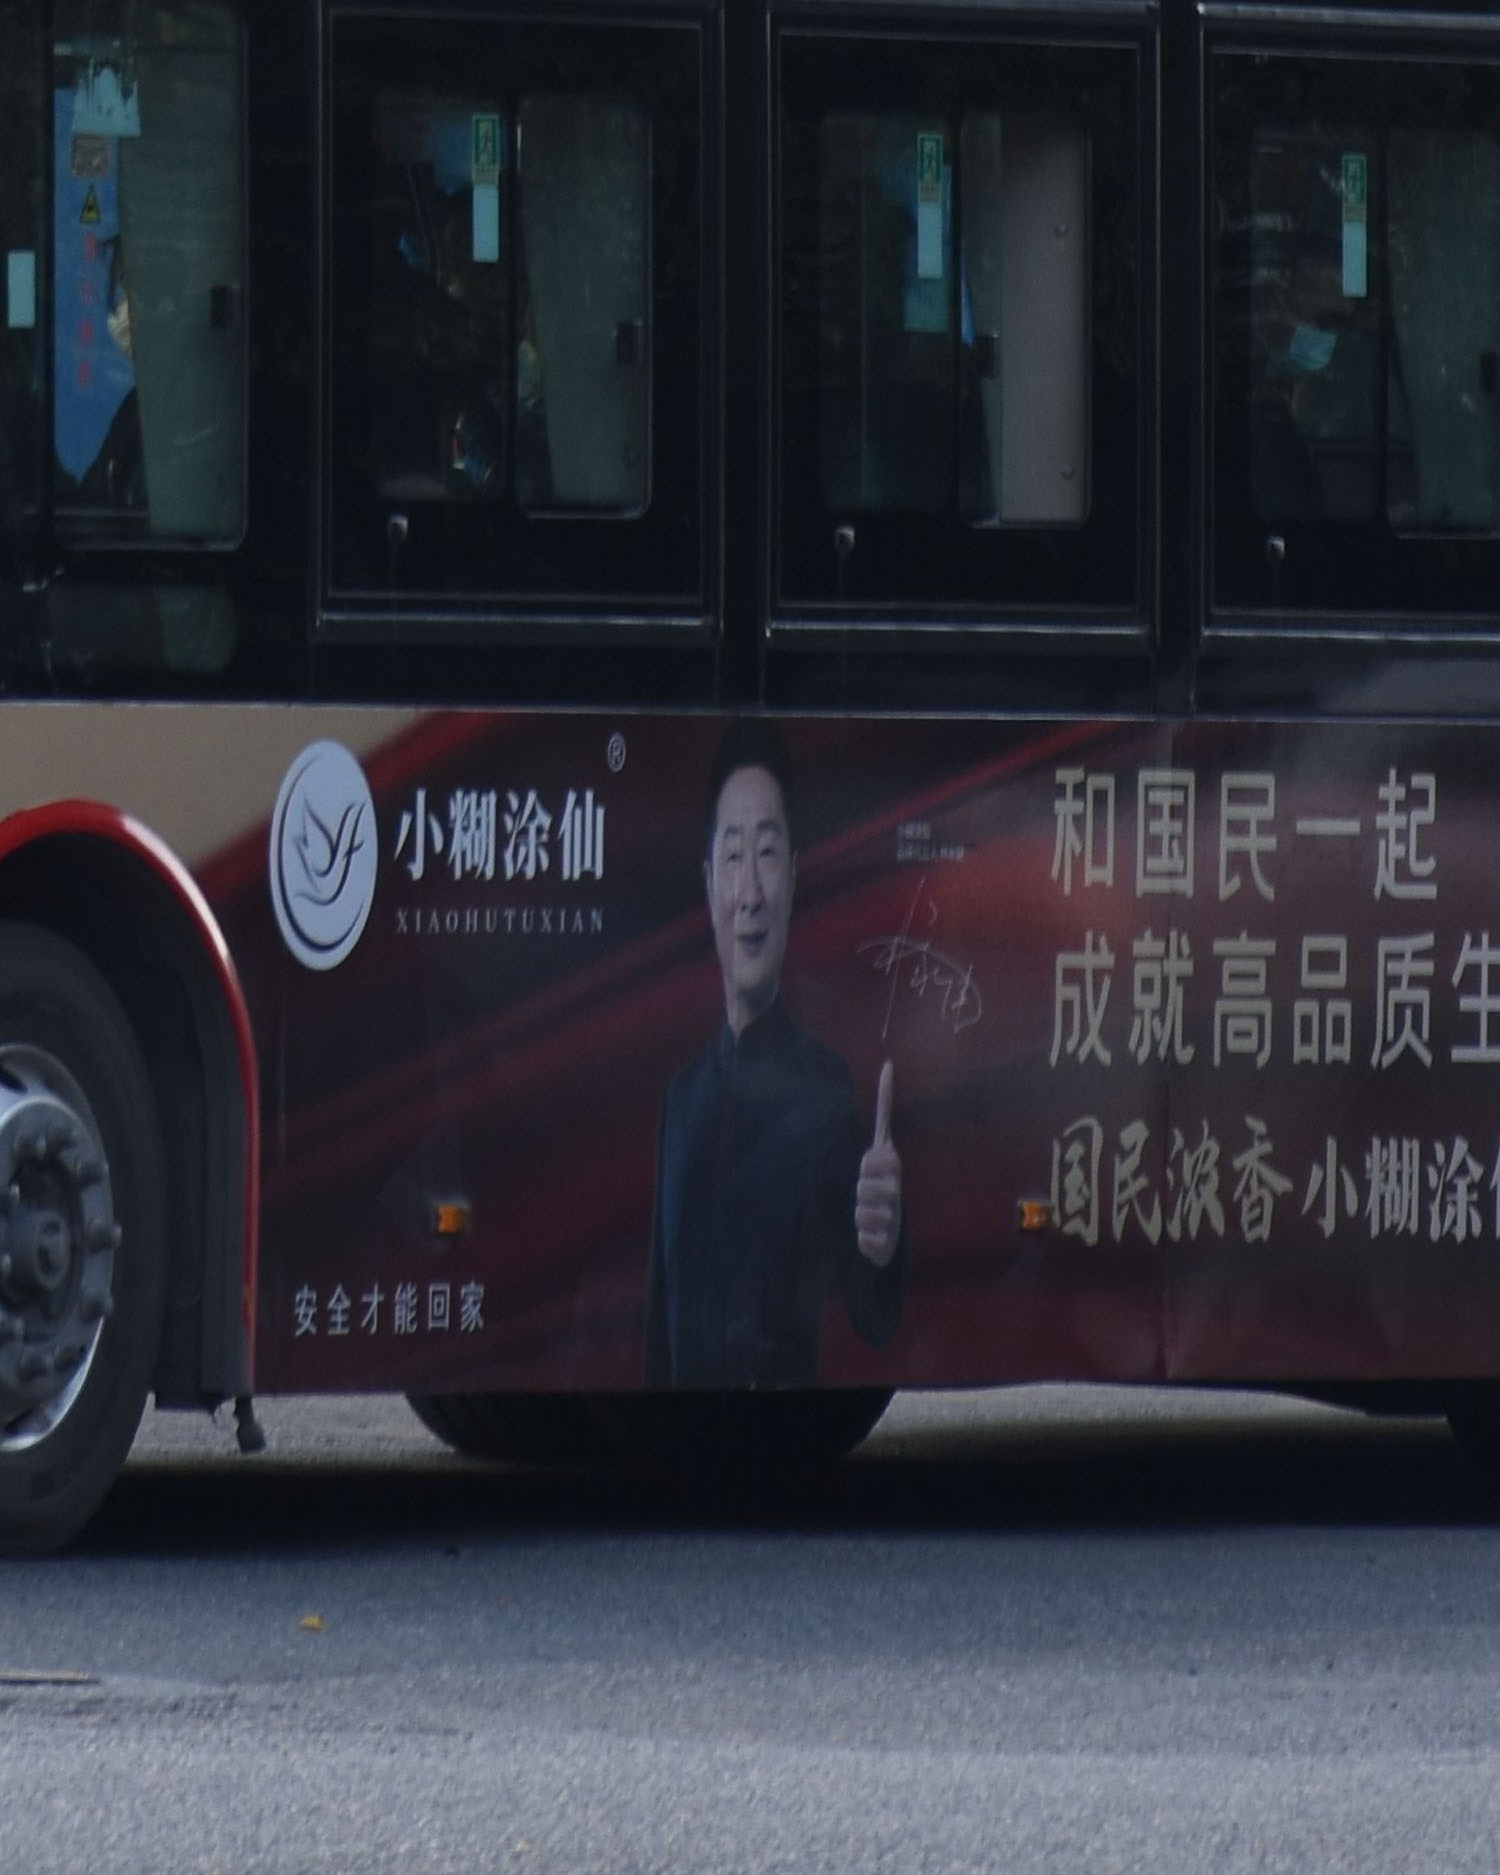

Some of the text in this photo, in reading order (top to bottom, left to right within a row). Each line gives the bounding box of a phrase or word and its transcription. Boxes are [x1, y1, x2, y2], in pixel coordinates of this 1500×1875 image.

[393, 786, 607, 883] 小糊涂仙
[1050, 765, 1438, 902] 和国民一起
[394, 906, 606, 936] XIAOHUTUXIAN
[293, 1278, 486, 1339] 安全才能回家
